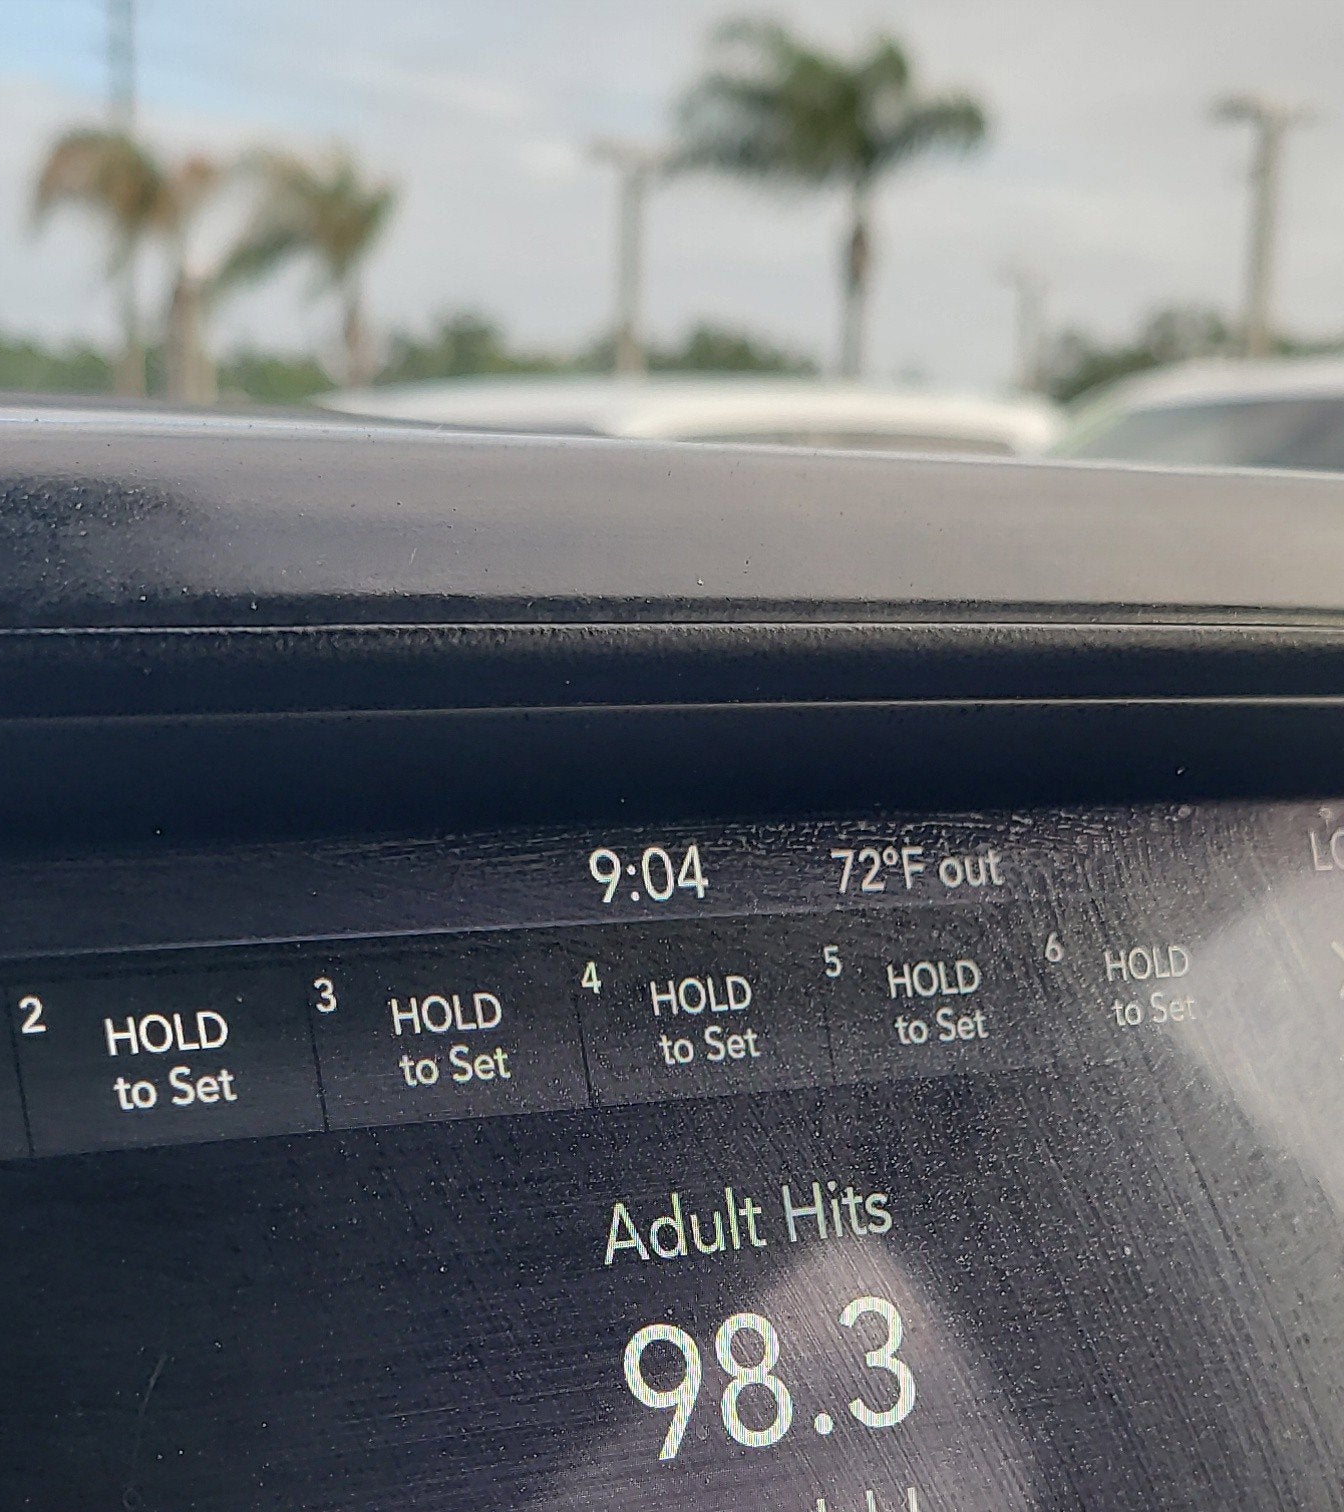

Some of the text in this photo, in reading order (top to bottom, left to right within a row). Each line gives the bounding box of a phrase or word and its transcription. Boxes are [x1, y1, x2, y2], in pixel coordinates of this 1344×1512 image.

[589, 845, 709, 904] 9:04
[939, 848, 1003, 890] out
[823, 946, 843, 979] 5
[1045, 932, 1064, 963] 6
[1104, 944, 1190, 983] HOLD
[313, 978, 338, 1014] 3
[581, 962, 602, 996] 4
[650, 975, 752, 1017] HOLD
[887, 959, 982, 1000] HOLD
[18, 996, 45, 1034] 2
[390, 992, 502, 1036] HOLD
[895, 1008, 989, 1046] to Set
[1114, 992, 1197, 1028] to Set
[104, 1010, 228, 1057] HOLD
[659, 1026, 760, 1066] to Set
[400, 1044, 511, 1087] to Set
[113, 1064, 237, 1111] to Set
[604, 1180, 894, 1266] Adult Hits
[622, 1294, 916, 1461] 98.3
